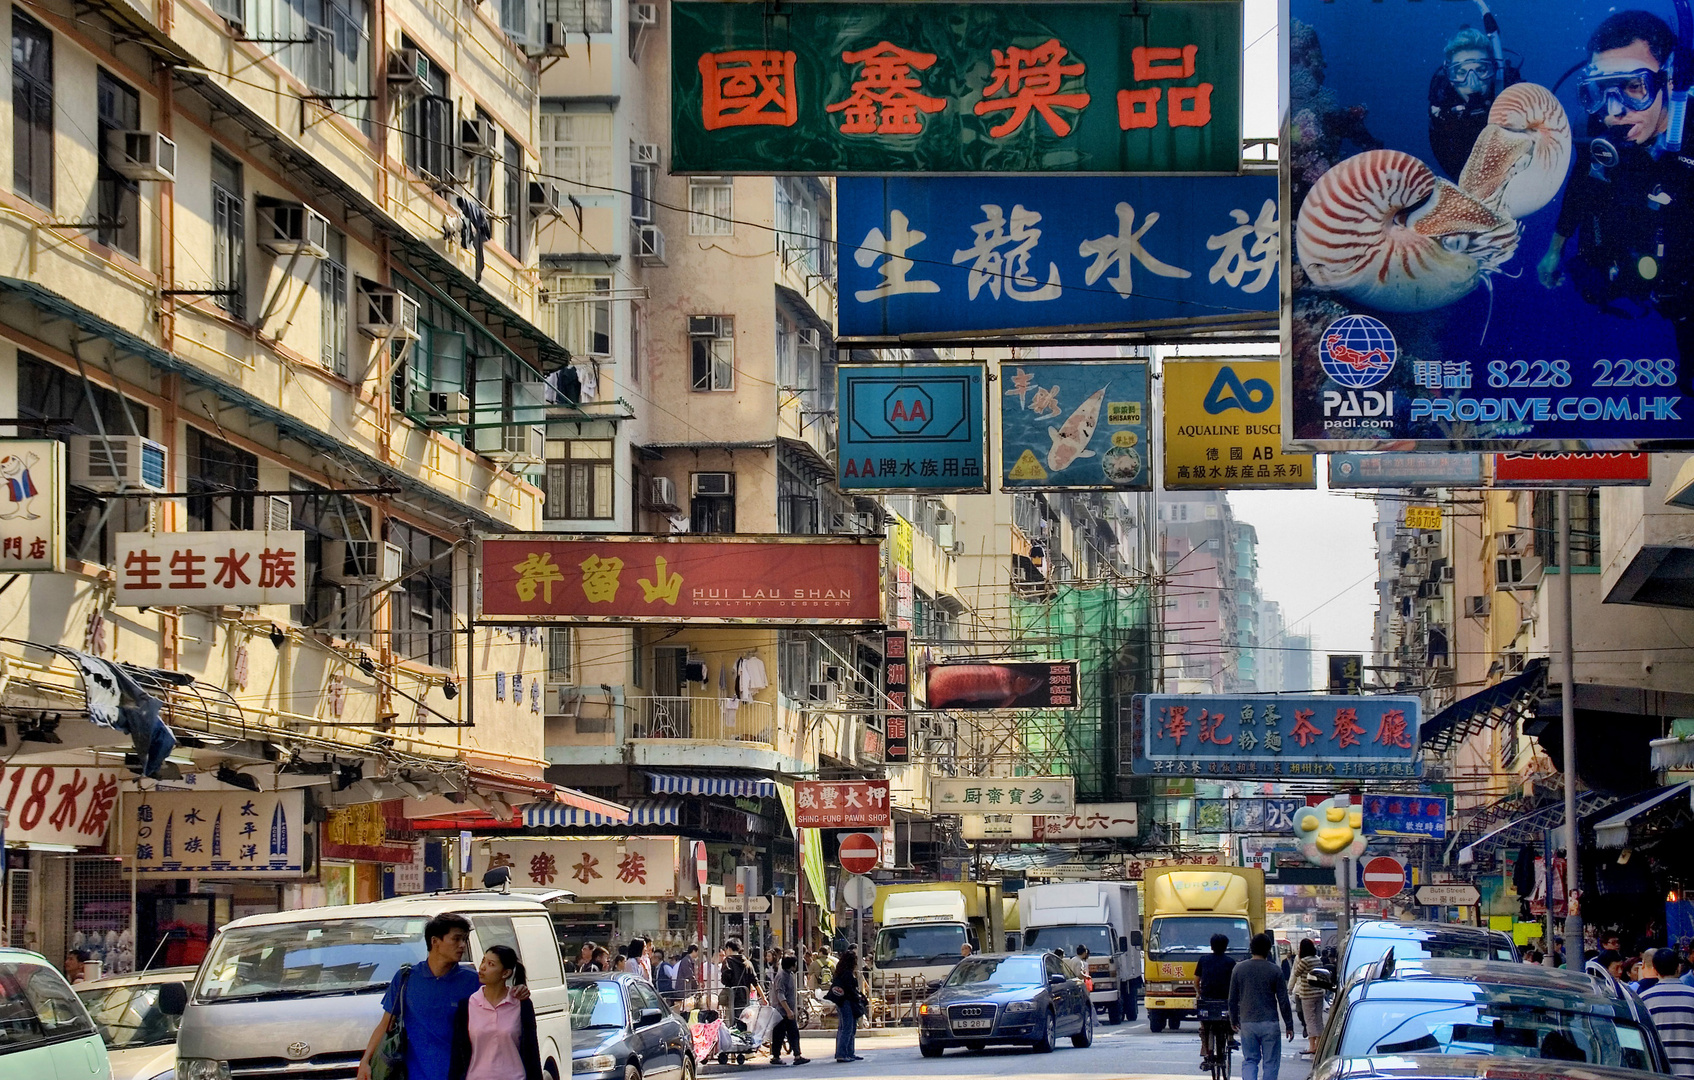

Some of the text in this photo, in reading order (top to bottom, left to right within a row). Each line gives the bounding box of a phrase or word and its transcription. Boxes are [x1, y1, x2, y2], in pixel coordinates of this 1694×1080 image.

[854, 202, 1280, 302] 生龍水族
[1412, 358, 1678, 389] 電話 8228 2288
[890, 399, 927, 422] AA
[1323, 391, 1394, 417] PADI
[1410, 396, 1682, 421] PRODIVE.COM.HK
[1109, 414, 1140, 422] SHISARYO
[1323, 418, 1394, 430] padi.com
[1177, 425, 1240, 437] AQUALINE
[1206, 447, 1274, 461] 德國 AB
[844, 457, 980, 479] AA牌水族用品
[3, 536, 48, 561] 門店
[123, 548, 297, 590] 生生水族
[512, 552, 684, 605] 許留山
[693, 588, 852, 600] HUI LAU SHAN
[887, 637, 907, 739] 亞洲紅龍
[1157, 705, 1233, 746] 澤記
[1240, 704, 1282, 727] 魚蛋
[1288, 707, 1412, 749] 茶餐廳
[1238, 730, 1282, 752] 粉麵
[0, 759, 118, 837] 18水族
[797, 785, 888, 810] 盛豐大押
[184, 807, 206, 853] 水族
[239, 800, 259, 861] 太平洋
[798, 814, 888, 823] SHING FUNG PAWN SHOP
[1161, 963, 1185, 978] 蘋果
[957, 1020, 968, 1028] LS
